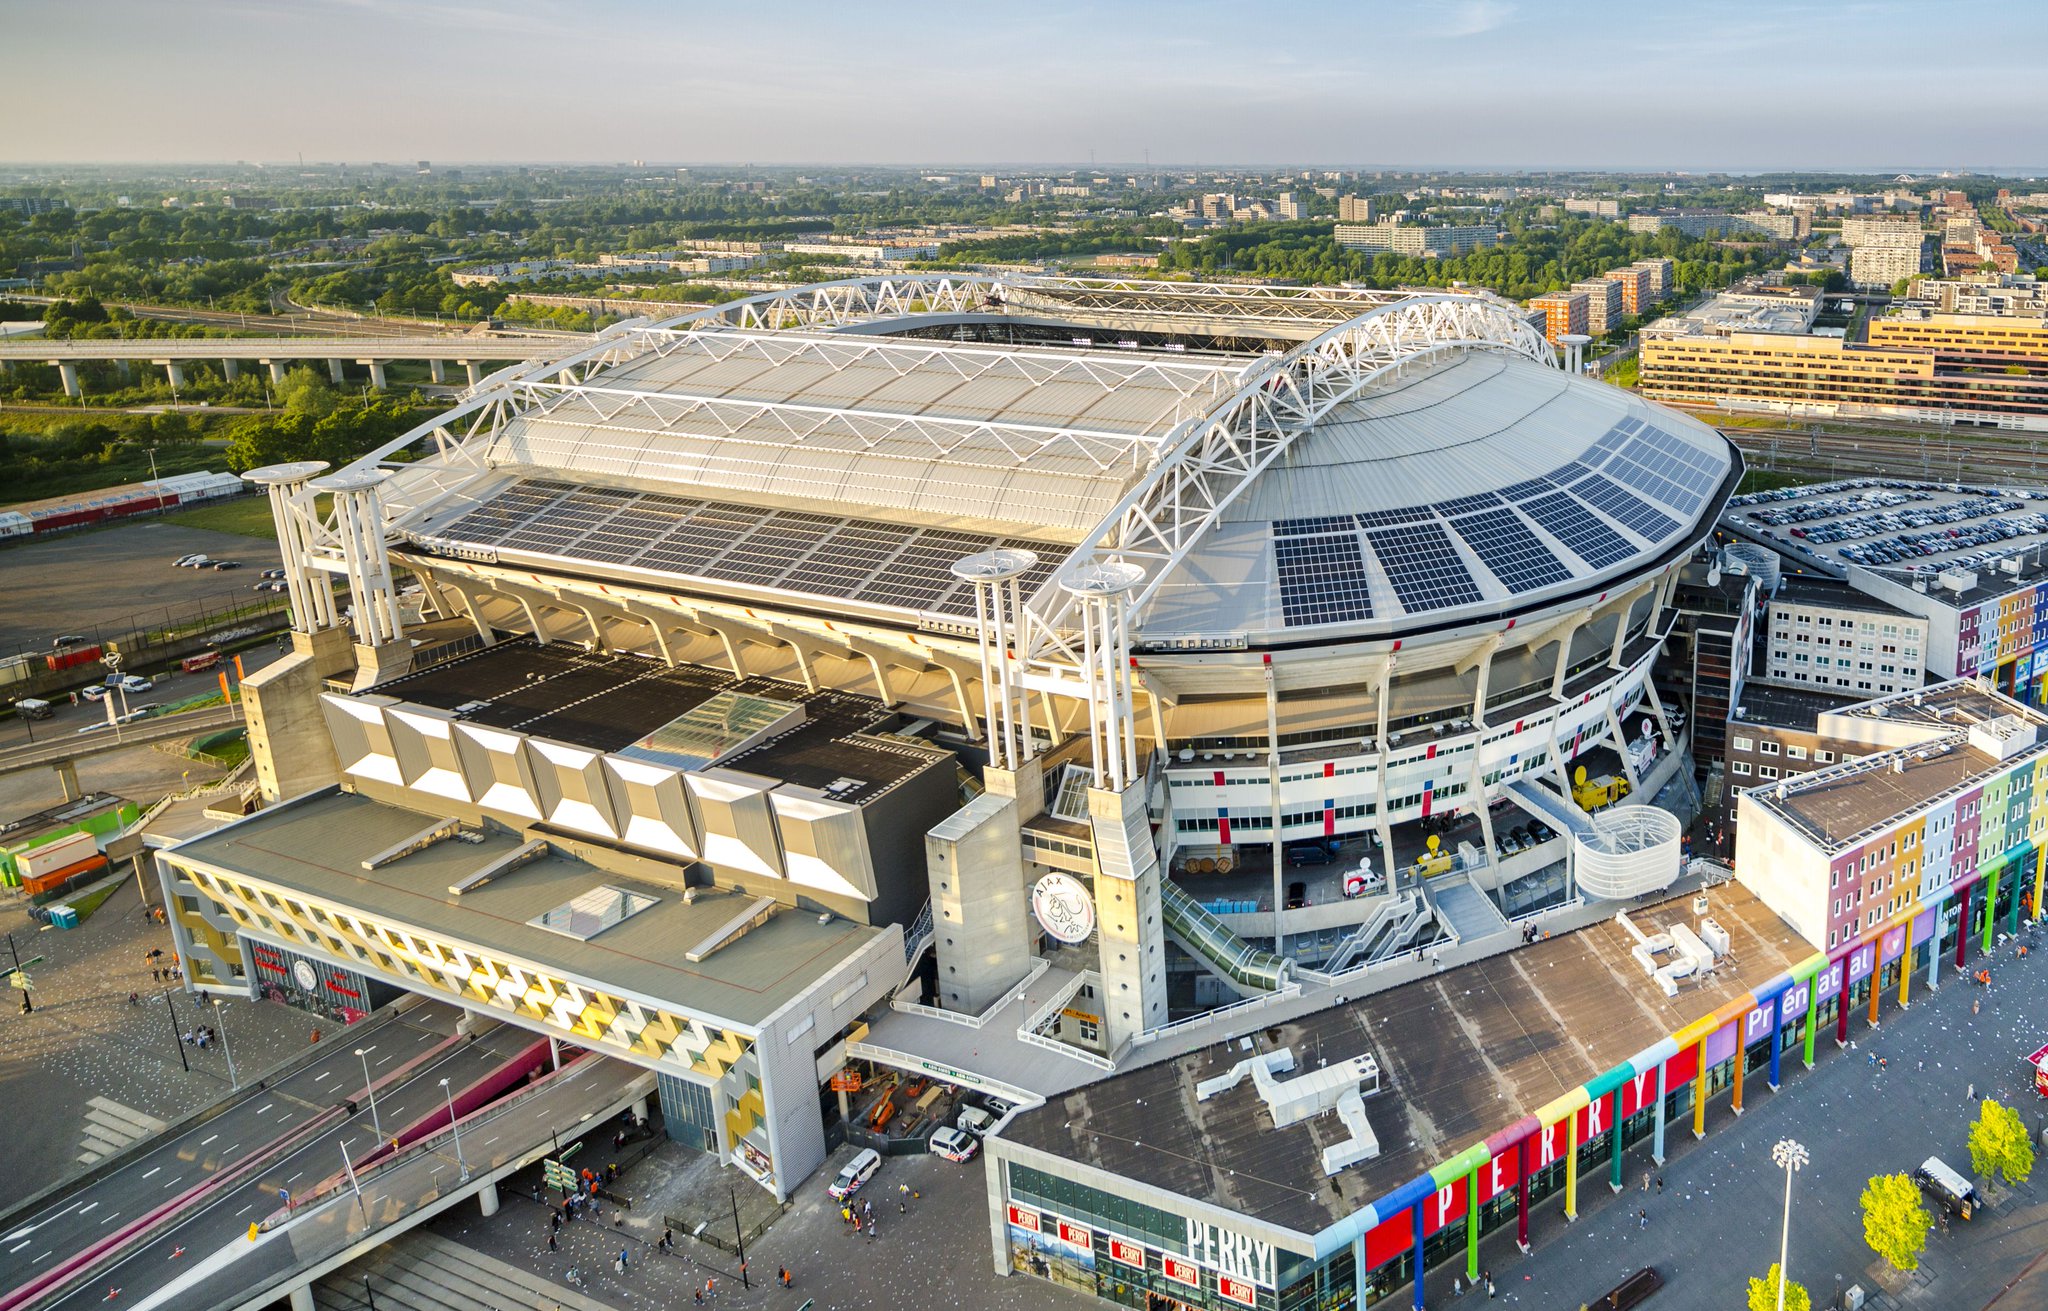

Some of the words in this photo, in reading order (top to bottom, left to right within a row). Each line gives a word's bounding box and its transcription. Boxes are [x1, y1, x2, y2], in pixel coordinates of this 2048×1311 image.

[1036, 877, 1062, 897] AJAX
[1438, 1072, 1646, 1228] PERRY
[1018, 1210, 1037, 1228] PERRY
[1068, 1225, 1088, 1244] PERRY
[1120, 1244, 1141, 1262] PERRY
[1186, 1218, 1271, 1284] PERRY
[1174, 1264, 1195, 1281] PERRY
[1230, 1283, 1251, 1301] PERRY
